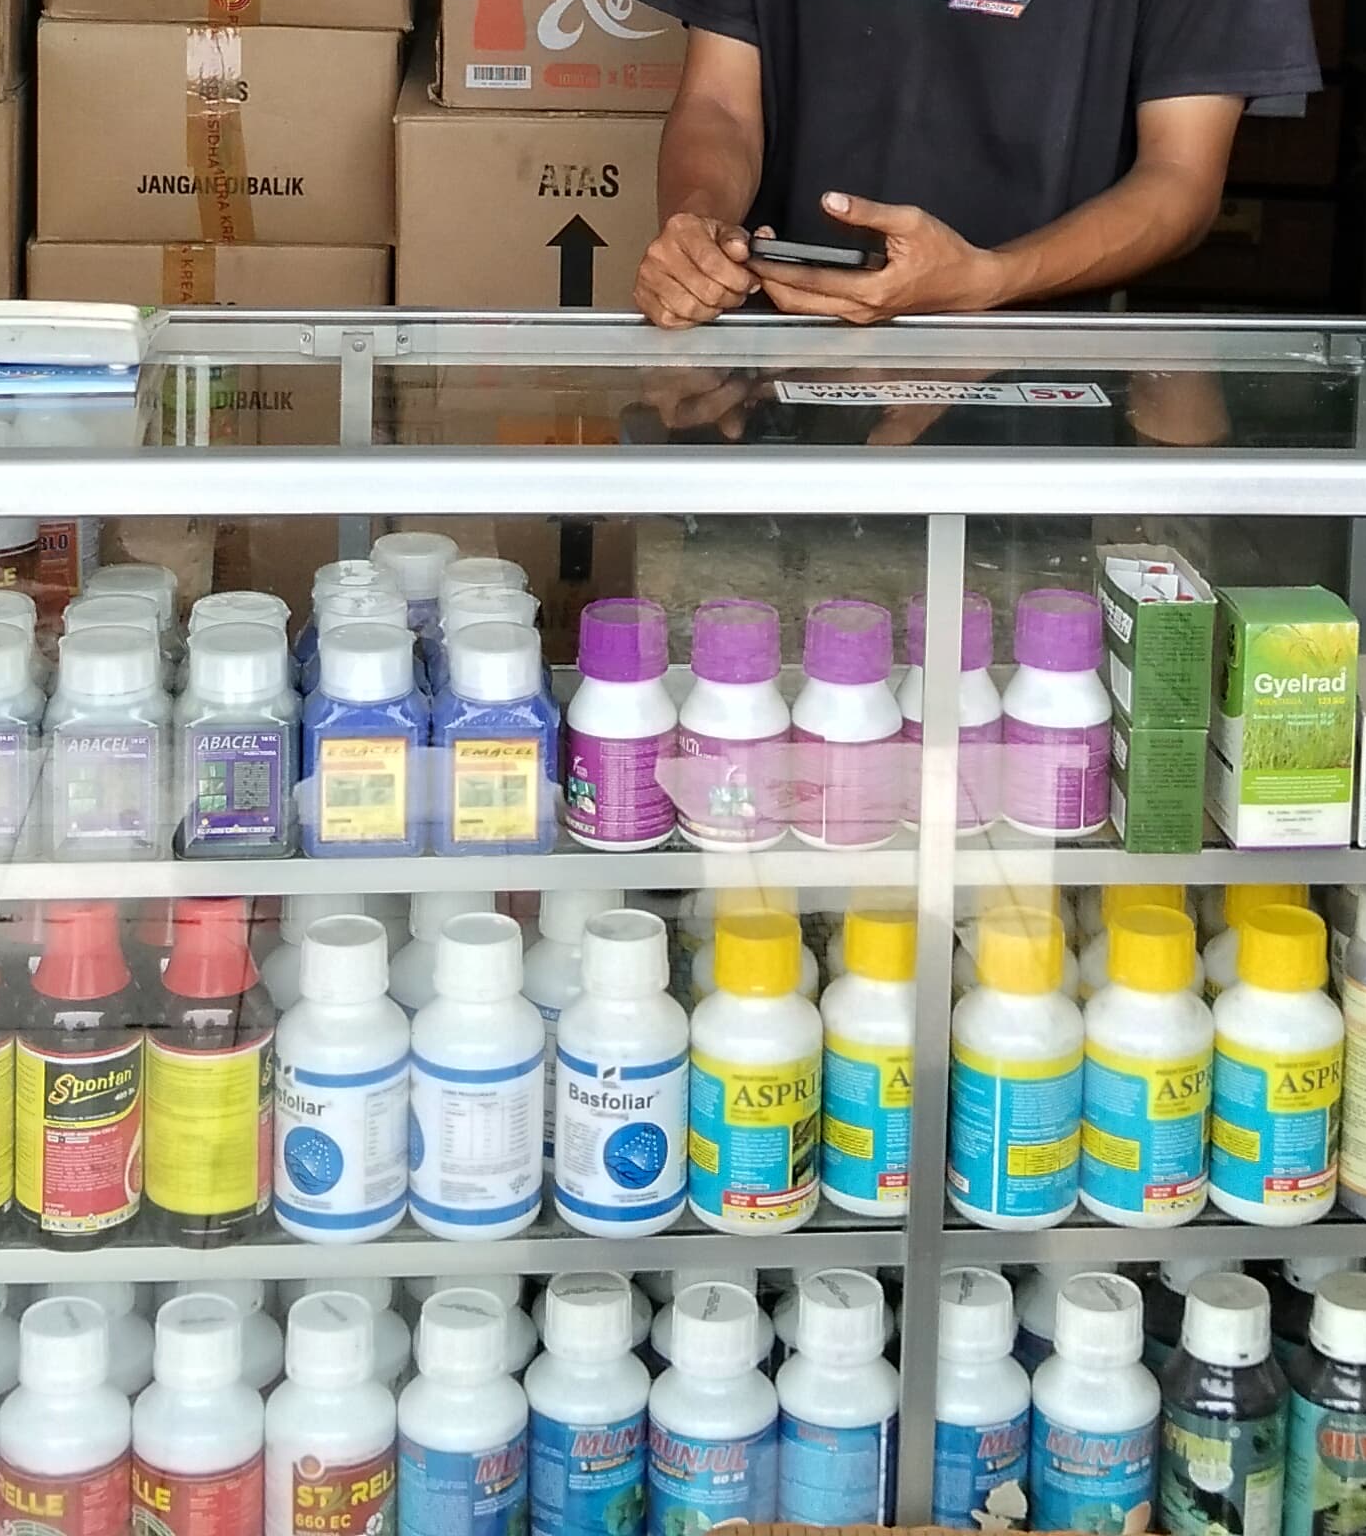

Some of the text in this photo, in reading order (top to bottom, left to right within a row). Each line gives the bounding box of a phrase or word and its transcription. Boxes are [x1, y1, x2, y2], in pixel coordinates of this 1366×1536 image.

[225, 175, 304, 197] DIBALIK
[538, 163, 620, 200] ATAS
[1254, 670, 1347, 699] Gyelrad
[66, 735, 131, 753] ABACEL
[197, 733, 259, 751] ABACEL
[459, 745, 534, 759] EMACEL
[50, 1068, 132, 1109] Spontan
[568, 1082, 655, 1112] Basfoliar
